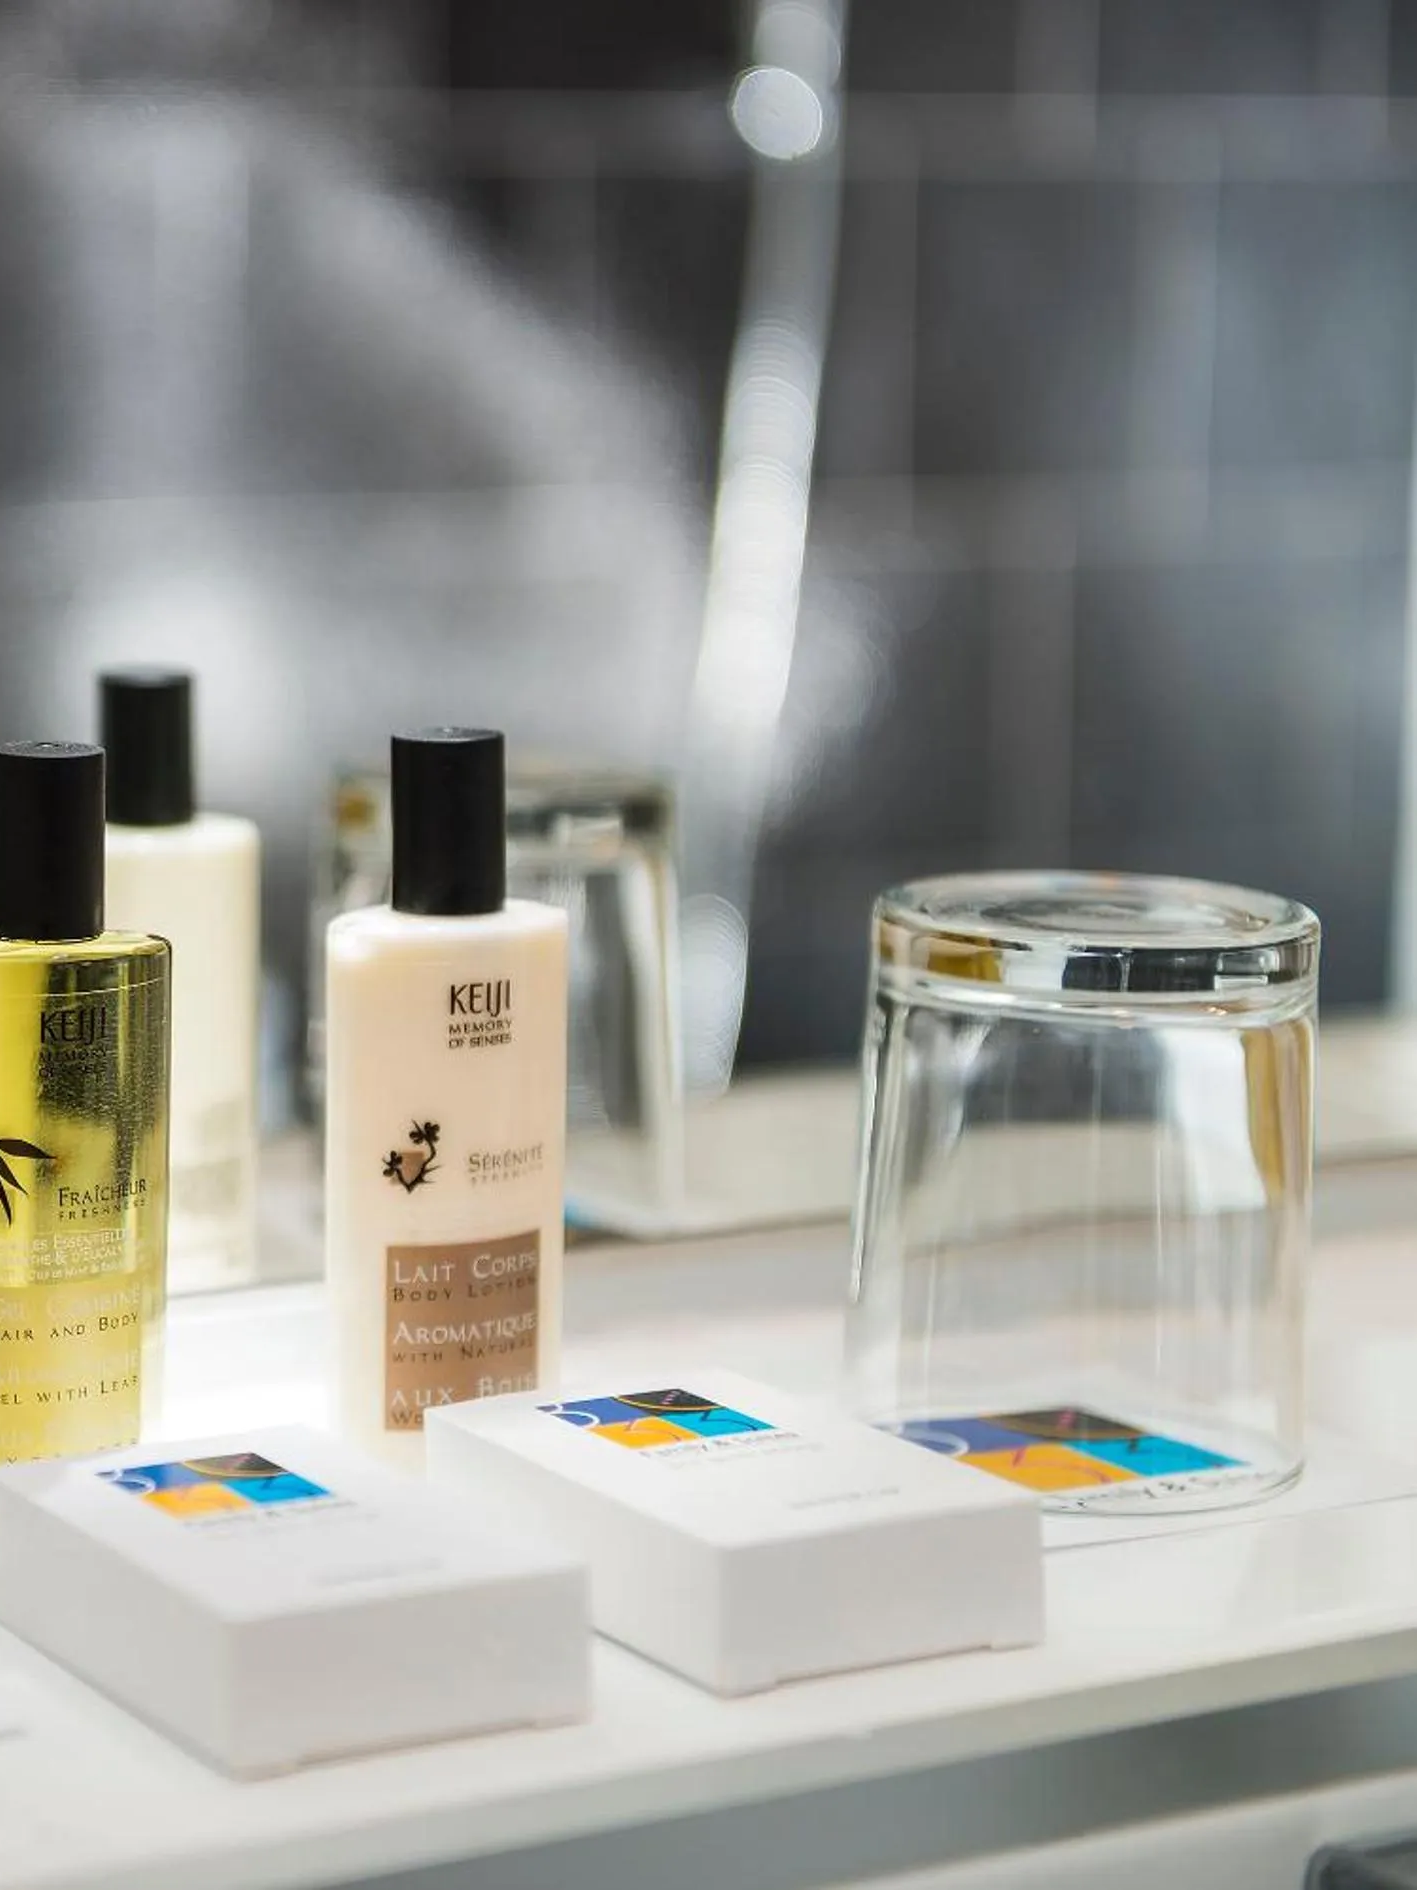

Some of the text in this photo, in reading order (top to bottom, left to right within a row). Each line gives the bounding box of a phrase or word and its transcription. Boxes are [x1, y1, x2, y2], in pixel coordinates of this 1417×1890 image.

[449, 979, 511, 1018] KEIJI
[39, 1006, 108, 1046] KEIJI
[448, 1019, 512, 1034] MEMORY
[394, 1260, 456, 1284] LAIT
[393, 1287, 453, 1303] BODY
[49, 1323, 86, 1340] AND
[98, 1312, 139, 1333] BODY
[392, 1312, 538, 1345] AROMATIQUE
[392, 1351, 444, 1364] WITH
[36, 1386, 88, 1404] WITH
